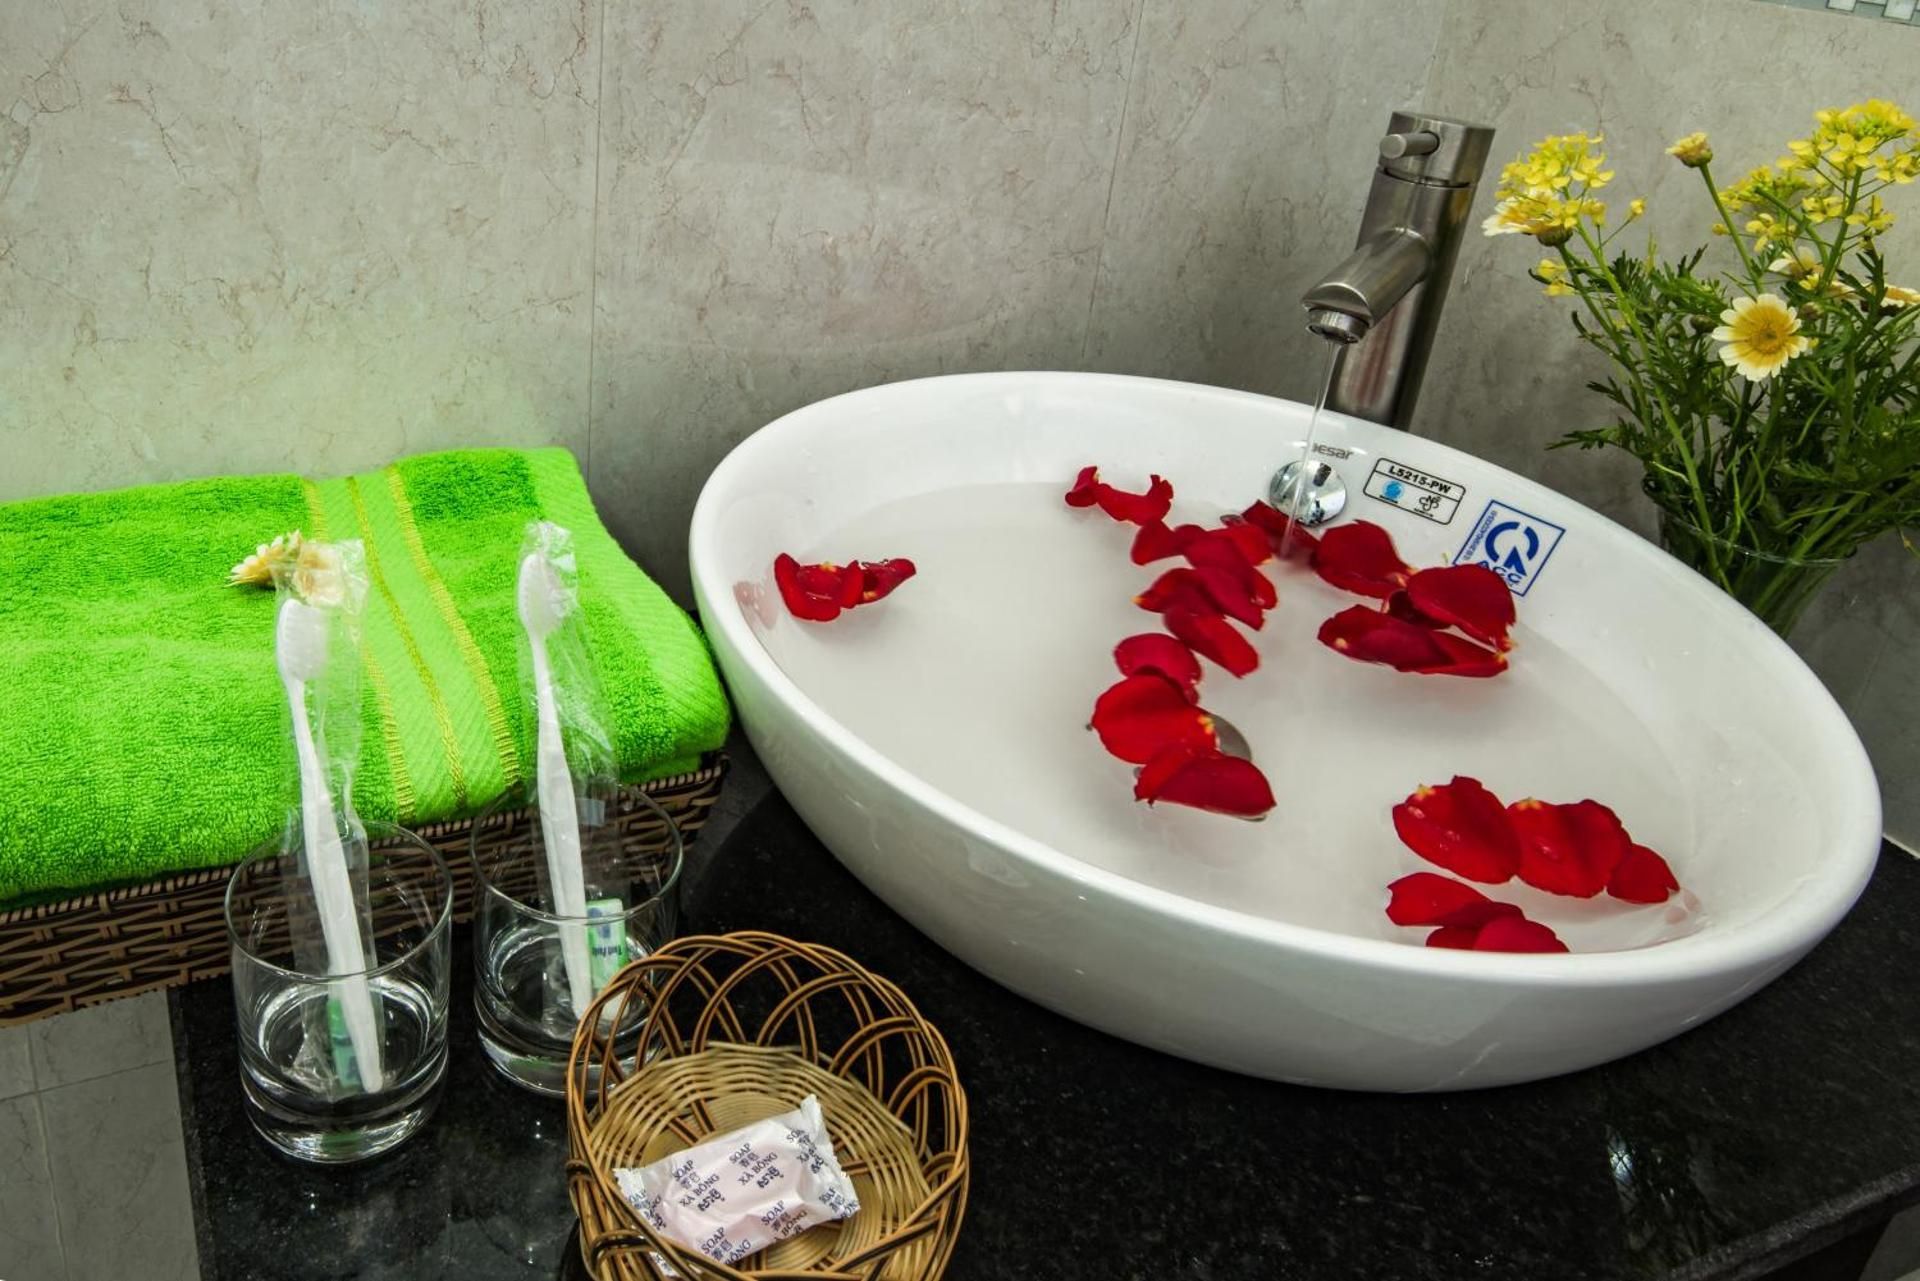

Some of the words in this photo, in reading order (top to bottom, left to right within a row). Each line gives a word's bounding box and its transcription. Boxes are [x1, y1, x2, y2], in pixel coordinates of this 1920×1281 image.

[1388, 465, 1451, 493] L5215-PW
[729, 1143, 751, 1164] SOAP
[751, 1152, 778, 1174] BÔNG
[671, 1160, 694, 1182] SOAP
[693, 1174, 720, 1196] BÔNG
[761, 1200, 785, 1226] SOAP
[701, 1227, 725, 1254] SOAP
